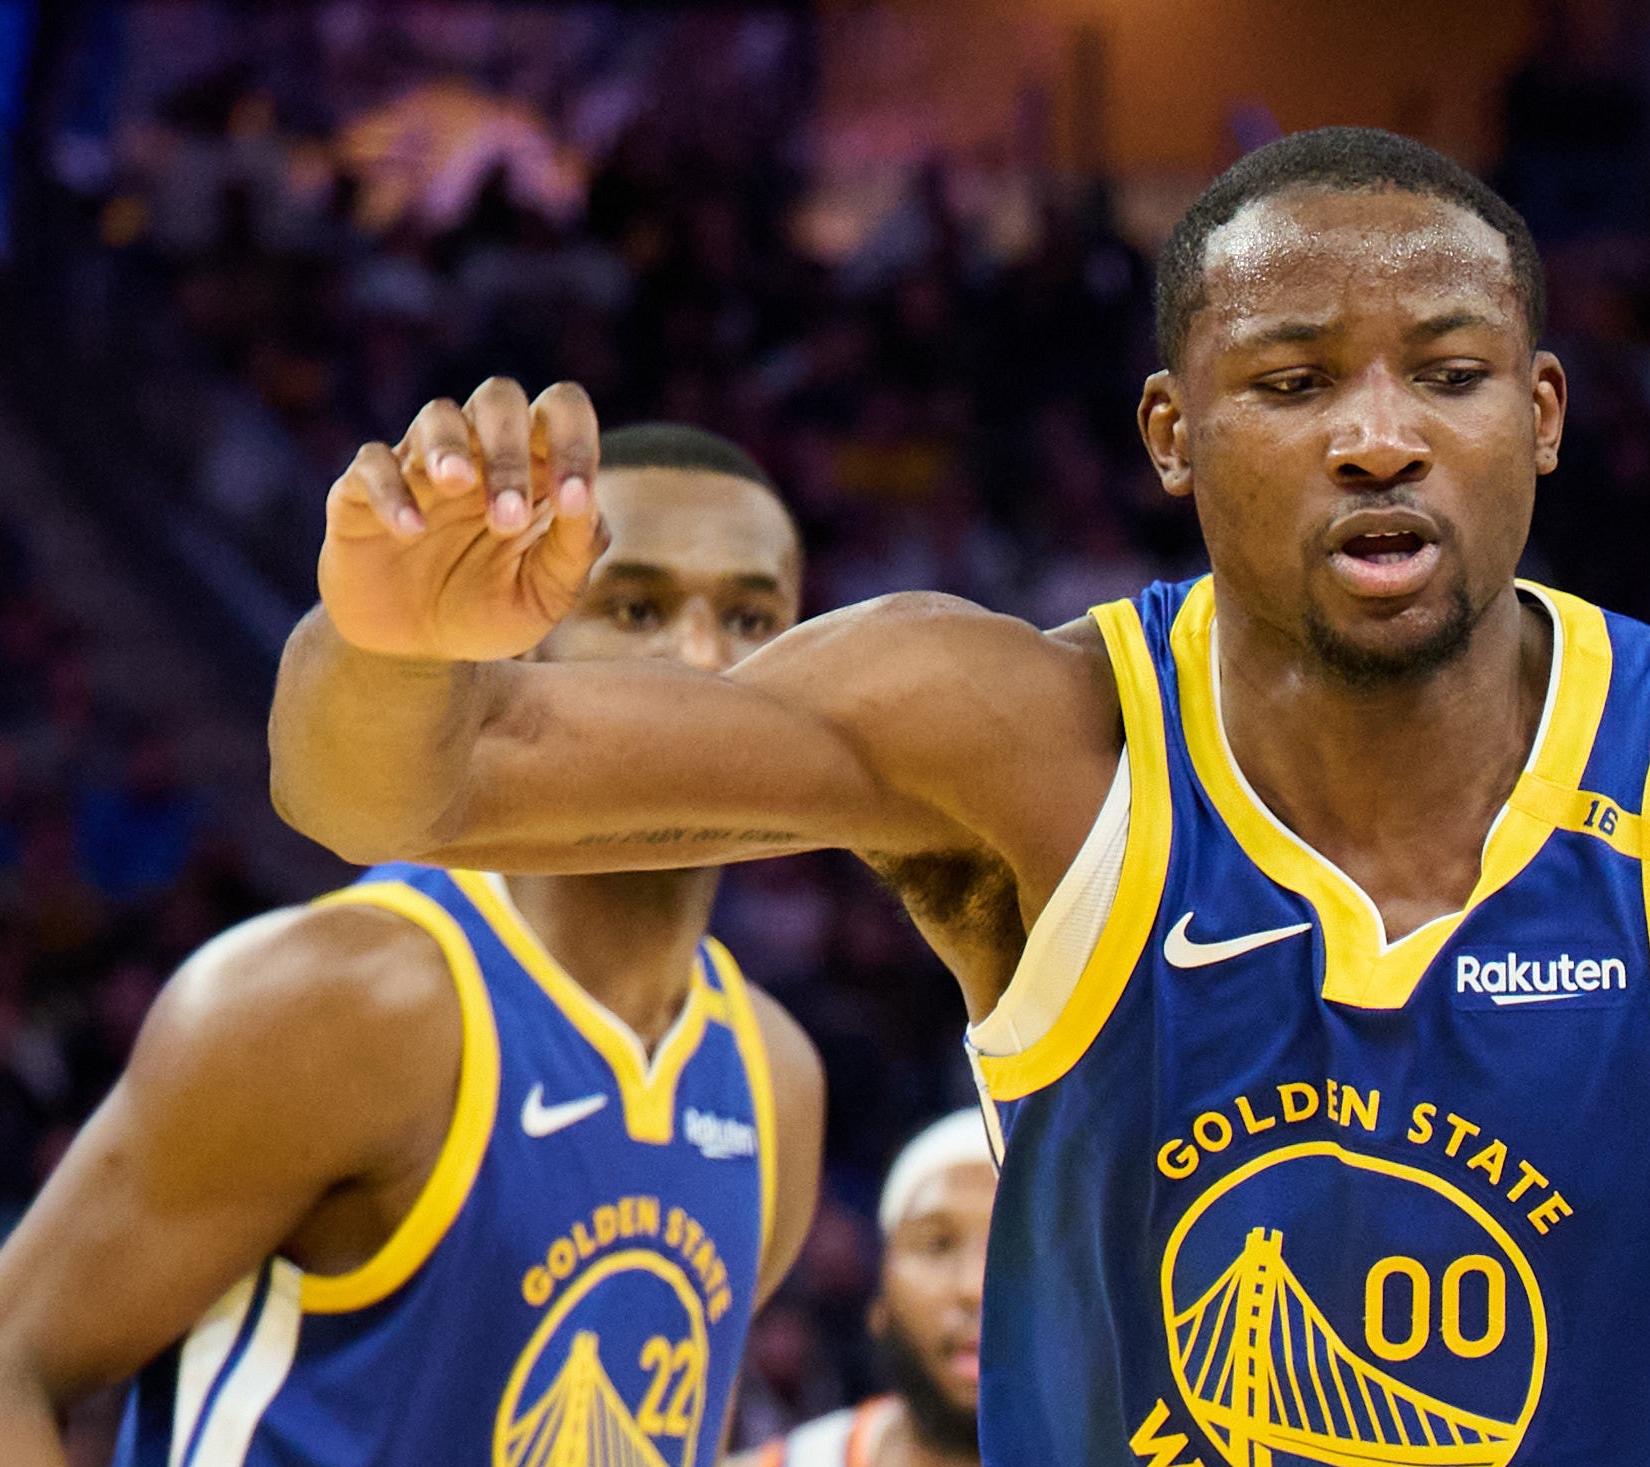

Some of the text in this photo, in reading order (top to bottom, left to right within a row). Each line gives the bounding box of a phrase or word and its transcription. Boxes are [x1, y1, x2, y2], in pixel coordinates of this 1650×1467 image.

[1583, 799, 1619, 836] 16
[1456, 951, 1627, 994] Rakuten
[1157, 1077, 1573, 1235] GOLDEN STATE
[521, 1194, 734, 1324] GOLDEN STATE
[1363, 1253, 1508, 1360] 00
[637, 1334, 700, 1438] 22
